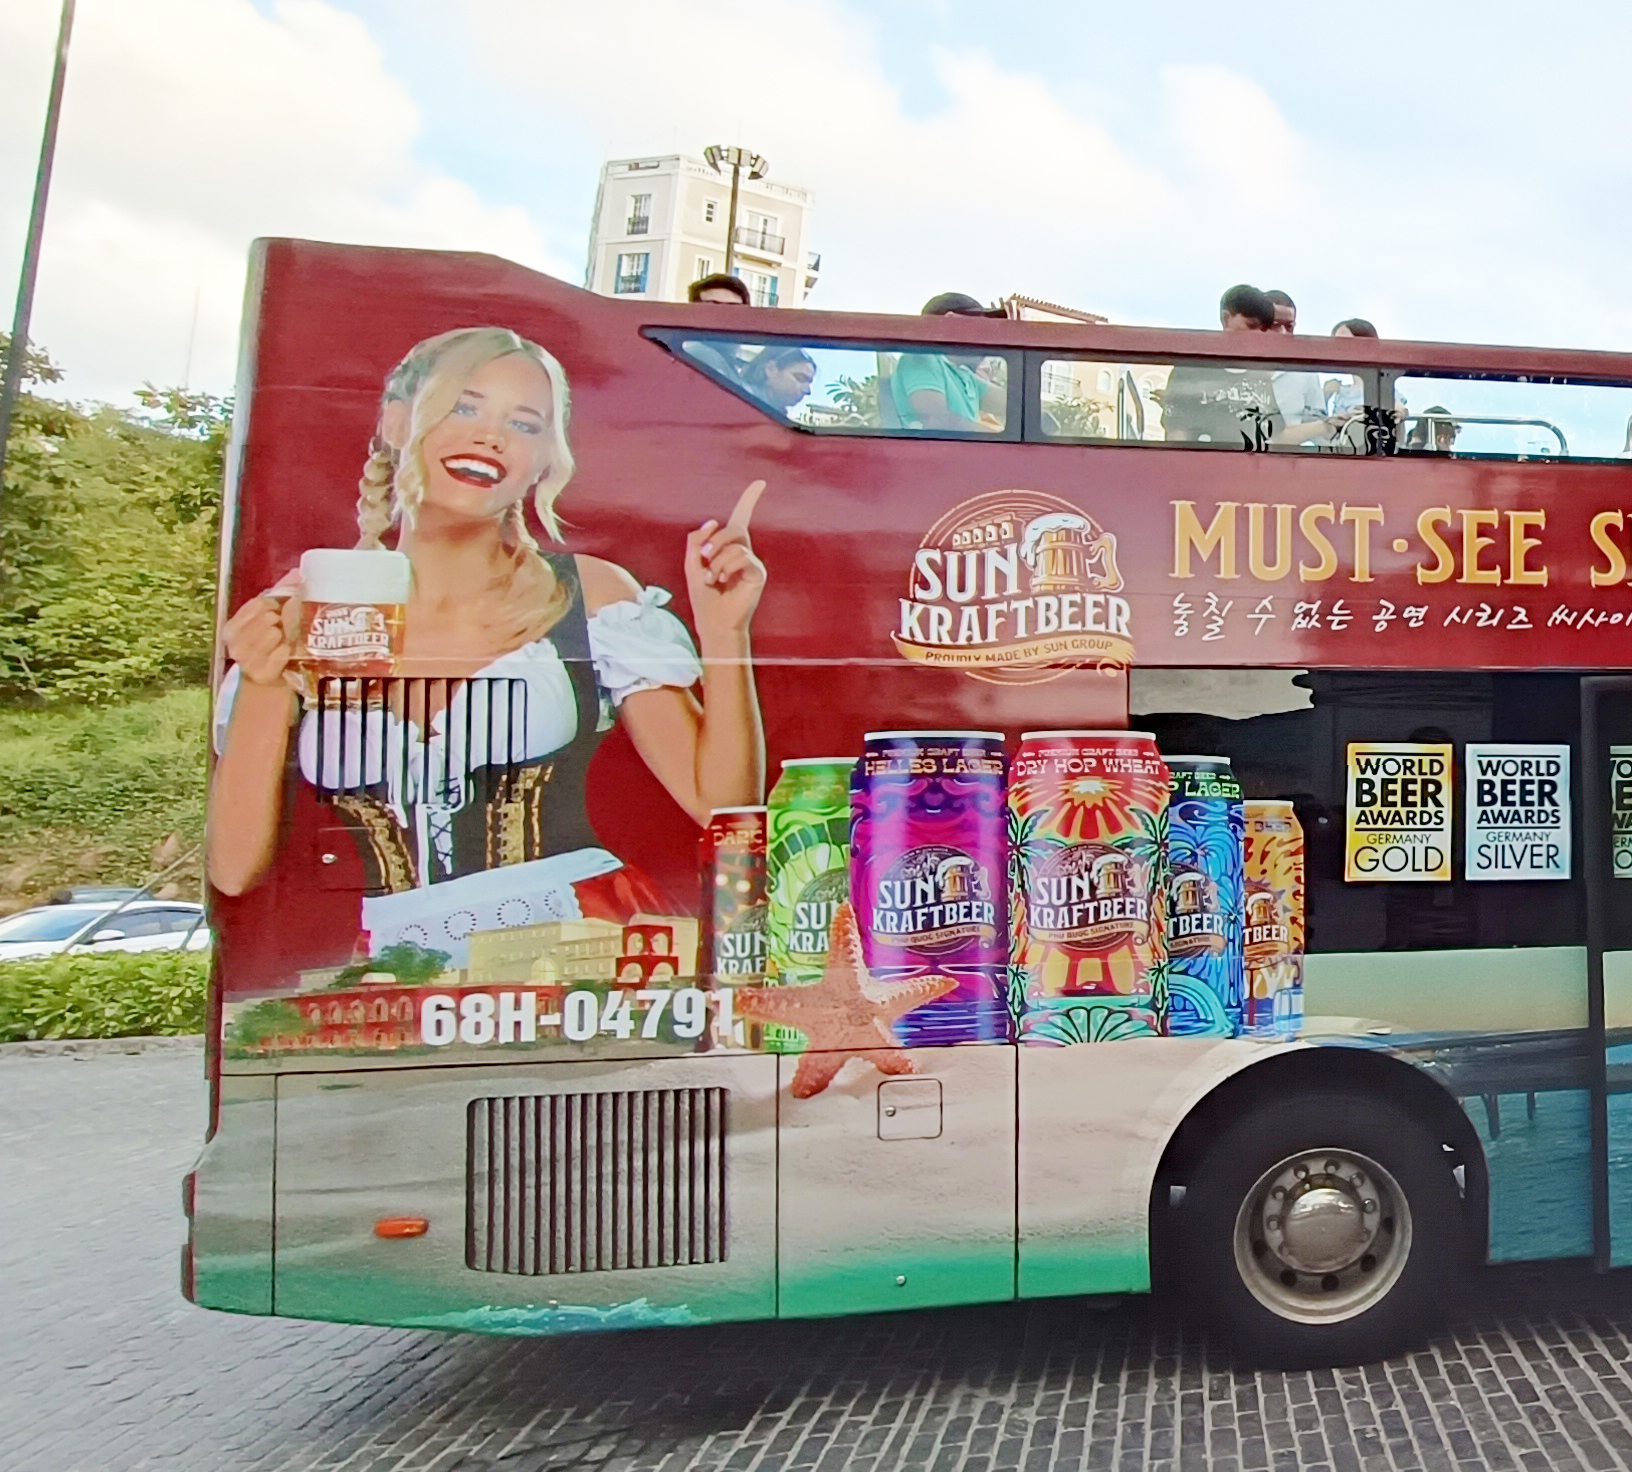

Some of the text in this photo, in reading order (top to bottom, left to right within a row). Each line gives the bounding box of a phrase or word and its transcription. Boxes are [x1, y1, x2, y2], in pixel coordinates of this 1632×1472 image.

[914, 542, 1021, 603] SUN
[899, 591, 1133, 646] KRAFTBEER
[1247, 595, 1277, 636] 수
[1290, 599, 1354, 632] 없는
[1372, 598, 1430, 633] 공연
[1443, 602, 1534, 630] 시리즈
[985, 650, 1021, 663] MADE
[1023, 646, 1040, 658] BY
[1043, 640, 1069, 655] SUN
[1071, 637, 1114, 651] GROUP
[864, 757, 1005, 777] HELLES LAGER
[1016, 757, 1162, 777] DRY HOP WHEAT
[1355, 757, 1445, 777] WORLD
[1476, 759, 1561, 777] WORLD
[1185, 780, 1241, 800] LAGER
[1354, 778, 1445, 808] BEER
[1476, 778, 1561, 808] BEER
[1354, 809, 1445, 826] AWARDS
[1476, 808, 1561, 825] AWARDS
[1366, 833, 1432, 845] GERMANY
[1485, 831, 1552, 843] GERMANY
[1354, 845, 1445, 873] GOLD
[1476, 843, 1561, 871] SILVER
[879, 875, 937, 910] SUN
[1036, 871, 1091, 906] SUN
[872, 900, 995, 934] KRAFTBEER
[1029, 896, 1148, 930] KRAFTBEER
[1243, 924, 1289, 946] TBEER
[420, 987, 735, 1047] 68H-04791
